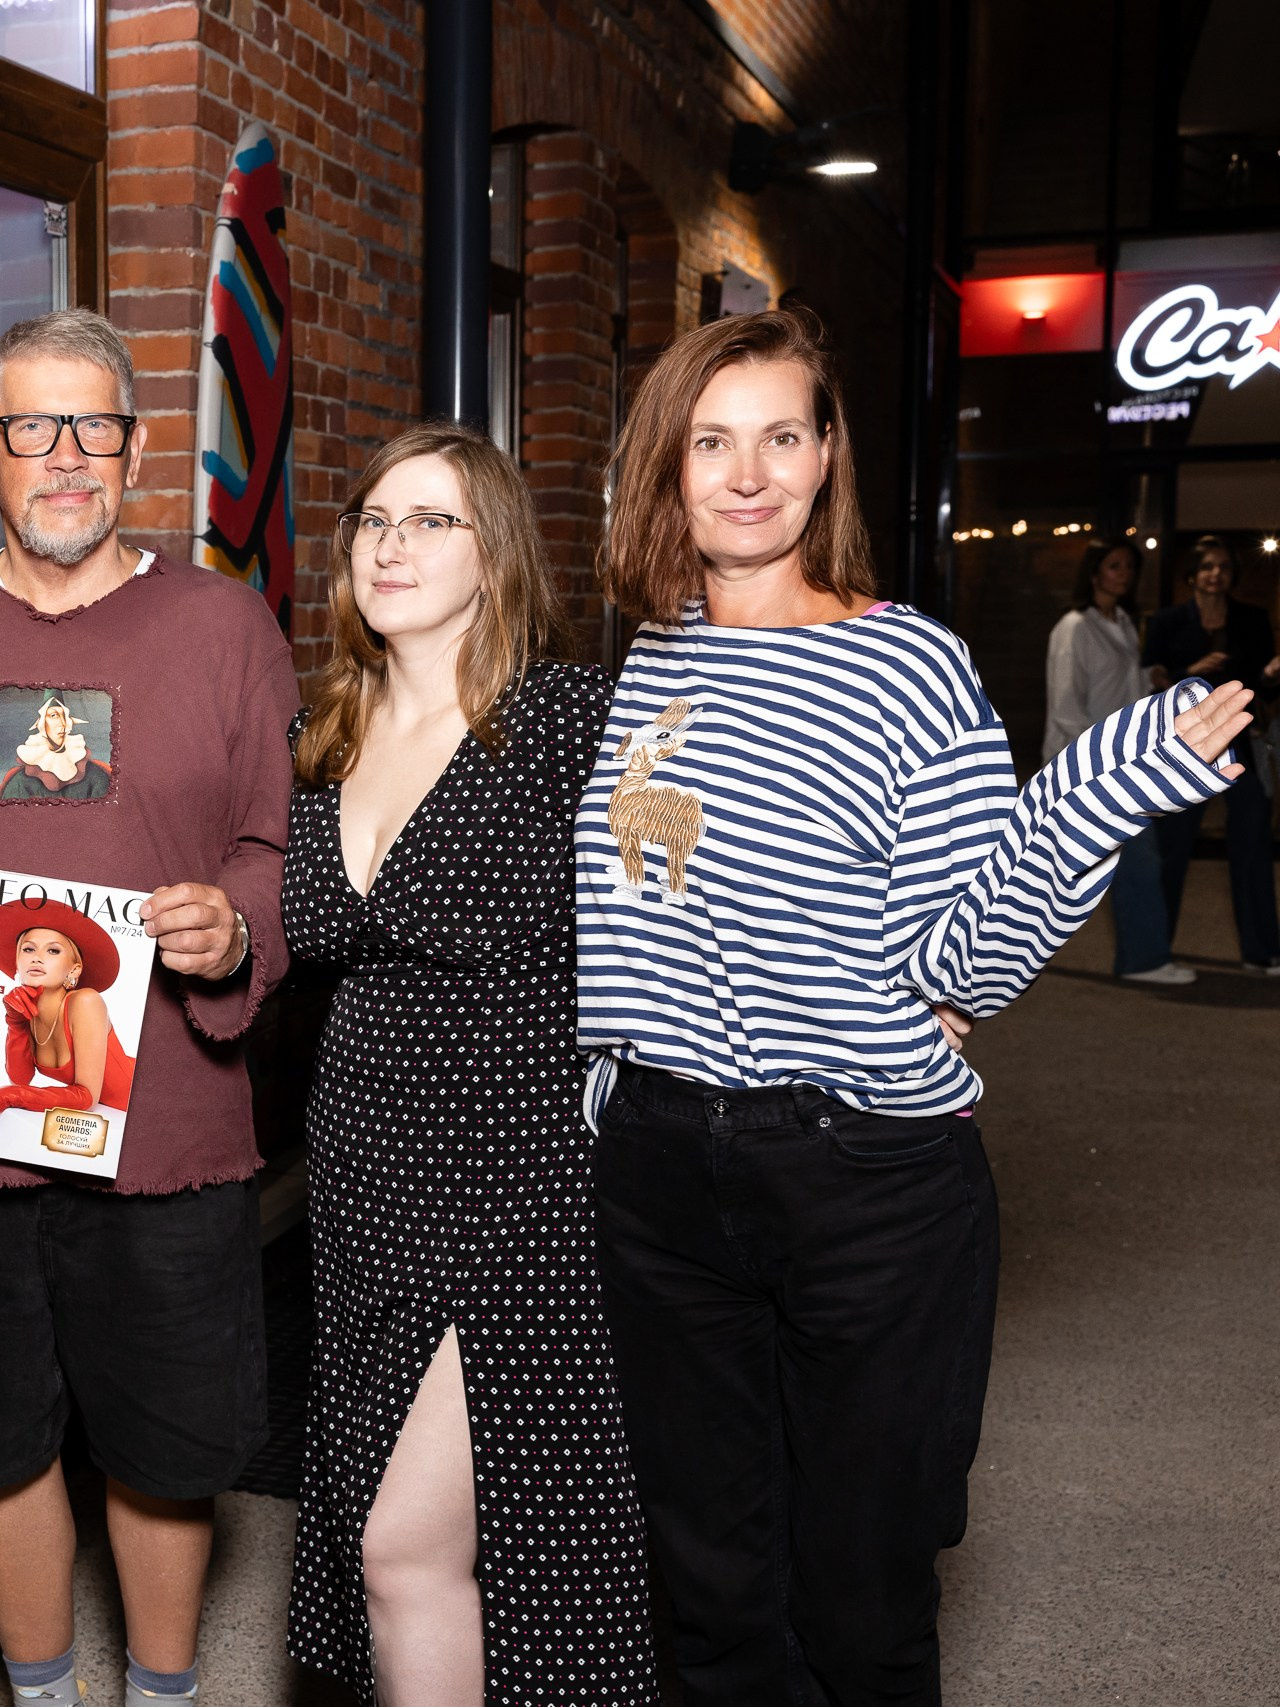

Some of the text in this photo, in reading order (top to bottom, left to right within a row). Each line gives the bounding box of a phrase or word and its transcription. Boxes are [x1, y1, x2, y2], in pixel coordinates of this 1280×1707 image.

[64, 888, 144, 926] MAG
[55, 1115, 97, 1128] GEOMETRIA
[58, 1124, 92, 1136] AWARDS:
[60, 1133, 88, 1142] ГОЛОСУЙ
[65, 1140, 90, 1150] ЛУЧШИХ
